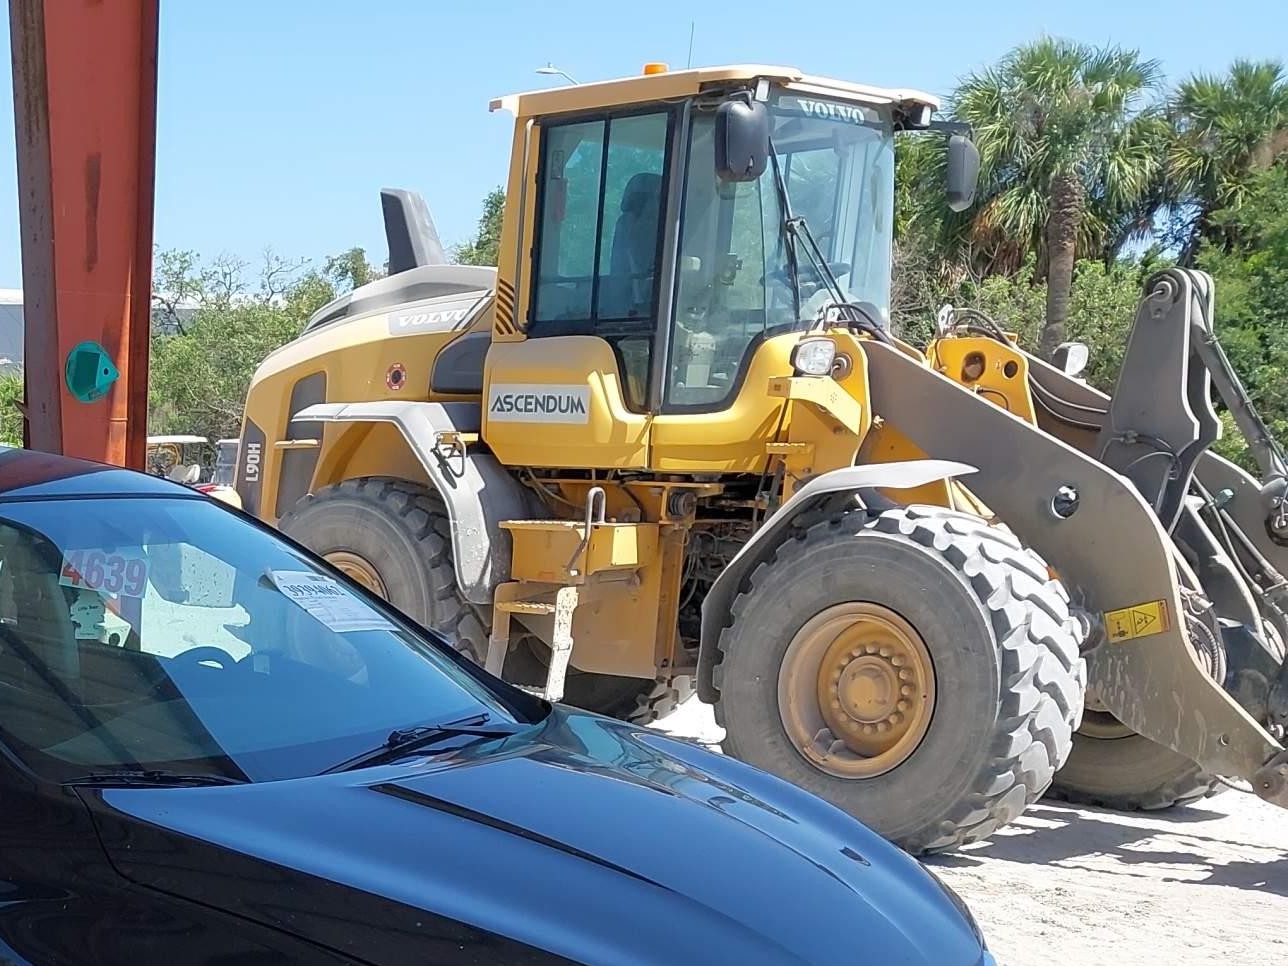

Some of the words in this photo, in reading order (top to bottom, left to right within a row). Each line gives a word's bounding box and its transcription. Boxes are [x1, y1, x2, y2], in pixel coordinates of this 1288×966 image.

[797, 99, 865, 125] VOLVO
[399, 308, 469, 328] VOLVO
[491, 394, 586, 415] ASCENDUM
[245, 443, 261, 482] L90H
[62, 552, 147, 597] 4639
